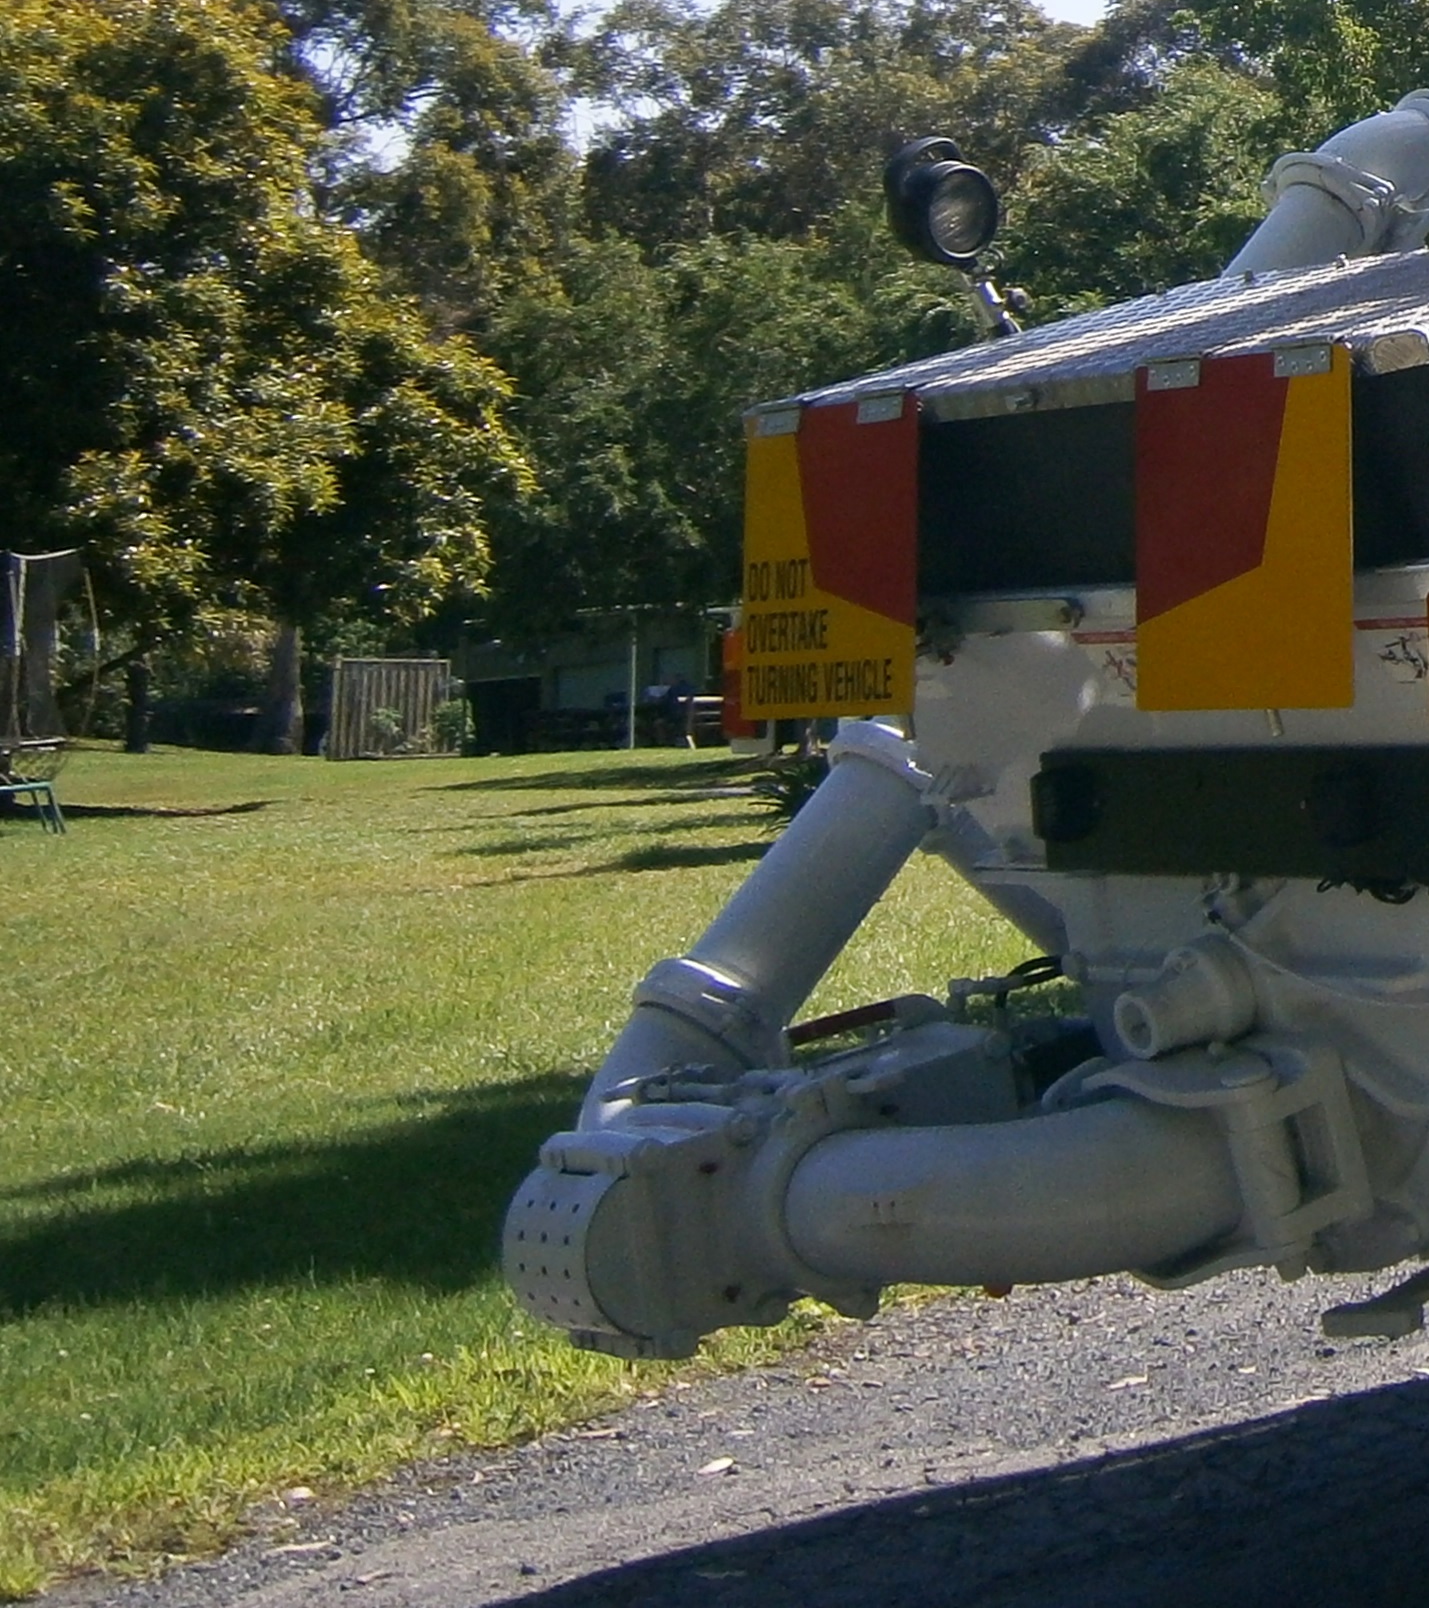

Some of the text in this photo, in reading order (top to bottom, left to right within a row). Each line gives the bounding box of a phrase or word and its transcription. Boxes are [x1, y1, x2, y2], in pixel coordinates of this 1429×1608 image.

[749, 558, 809, 603] DO NOT
[747, 609, 829, 654] OVERTAKE
[747, 658, 893, 706] TURNING VEHICLE
